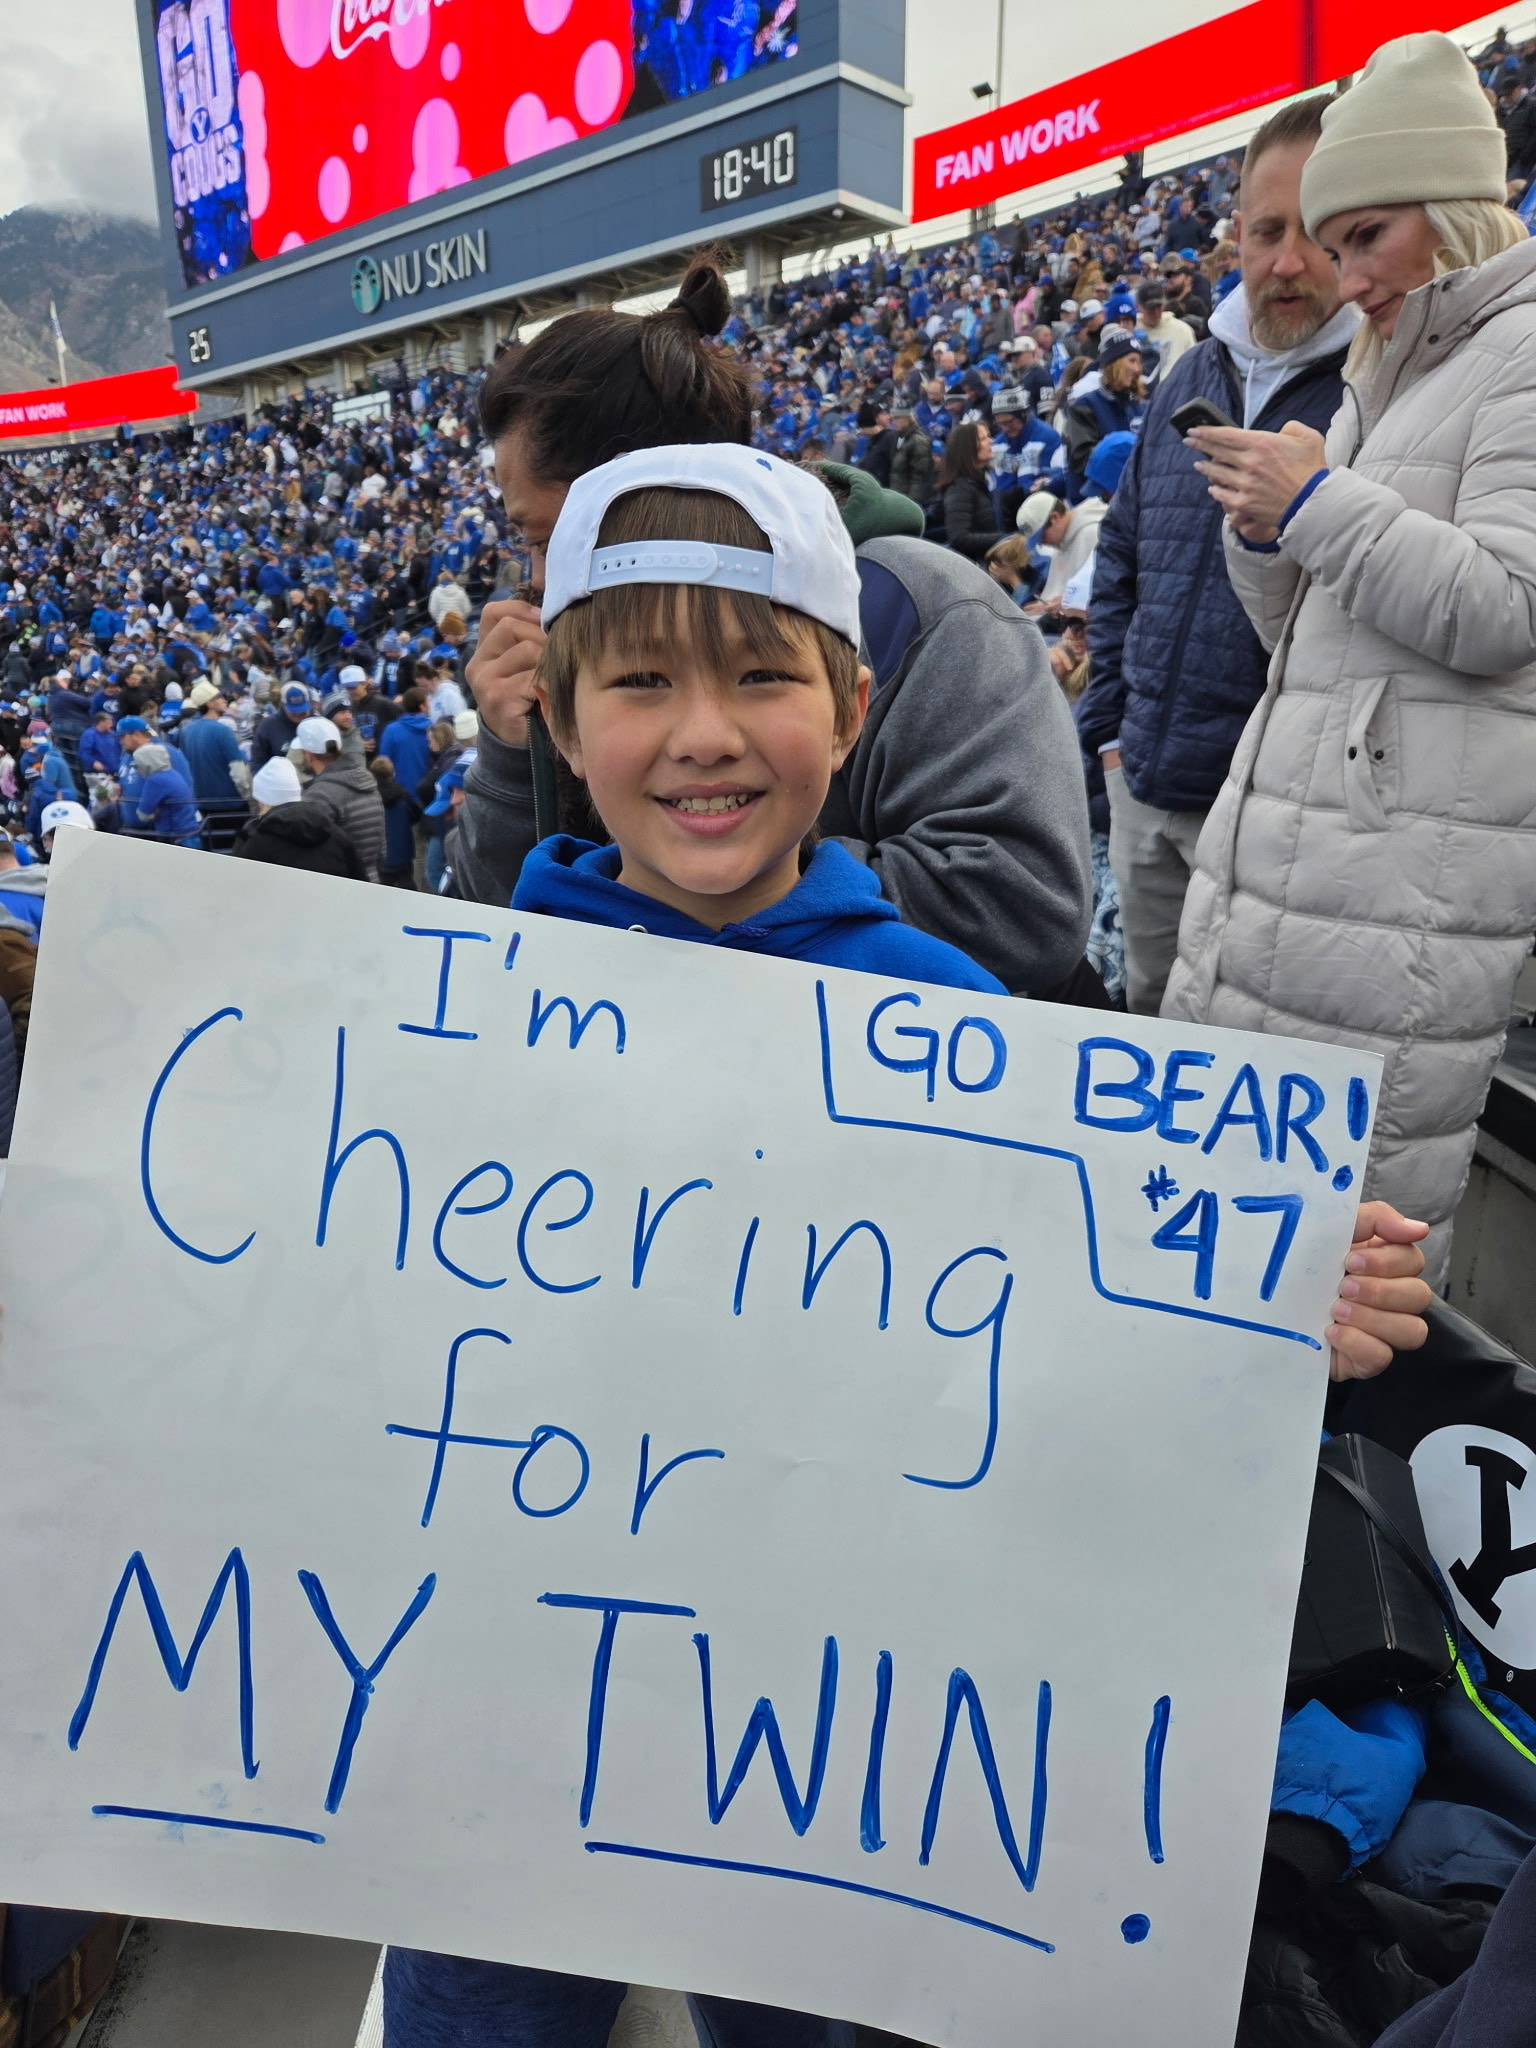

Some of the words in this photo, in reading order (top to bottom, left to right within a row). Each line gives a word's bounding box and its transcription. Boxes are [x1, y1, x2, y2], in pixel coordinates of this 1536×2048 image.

[713, 131, 795, 201] 18:40
[935, 140, 995, 190] FAN
[1000, 98, 1101, 166] WORK
[381, 249, 422, 302] NU
[425, 228, 487, 289] SKIN
[189, 327, 211, 363] 25
[24, 401, 68, 421] WORK
[396, 925, 627, 1055] I'm
[866, 991, 1008, 1103] GO
[1072, 1035, 1371, 1193] BEAR!
[139, 1005, 1016, 1491] Cheering
[1140, 1164, 1307, 1303] #47
[384, 1326, 727, 1536] for
[65, 1546, 438, 1815] MY
